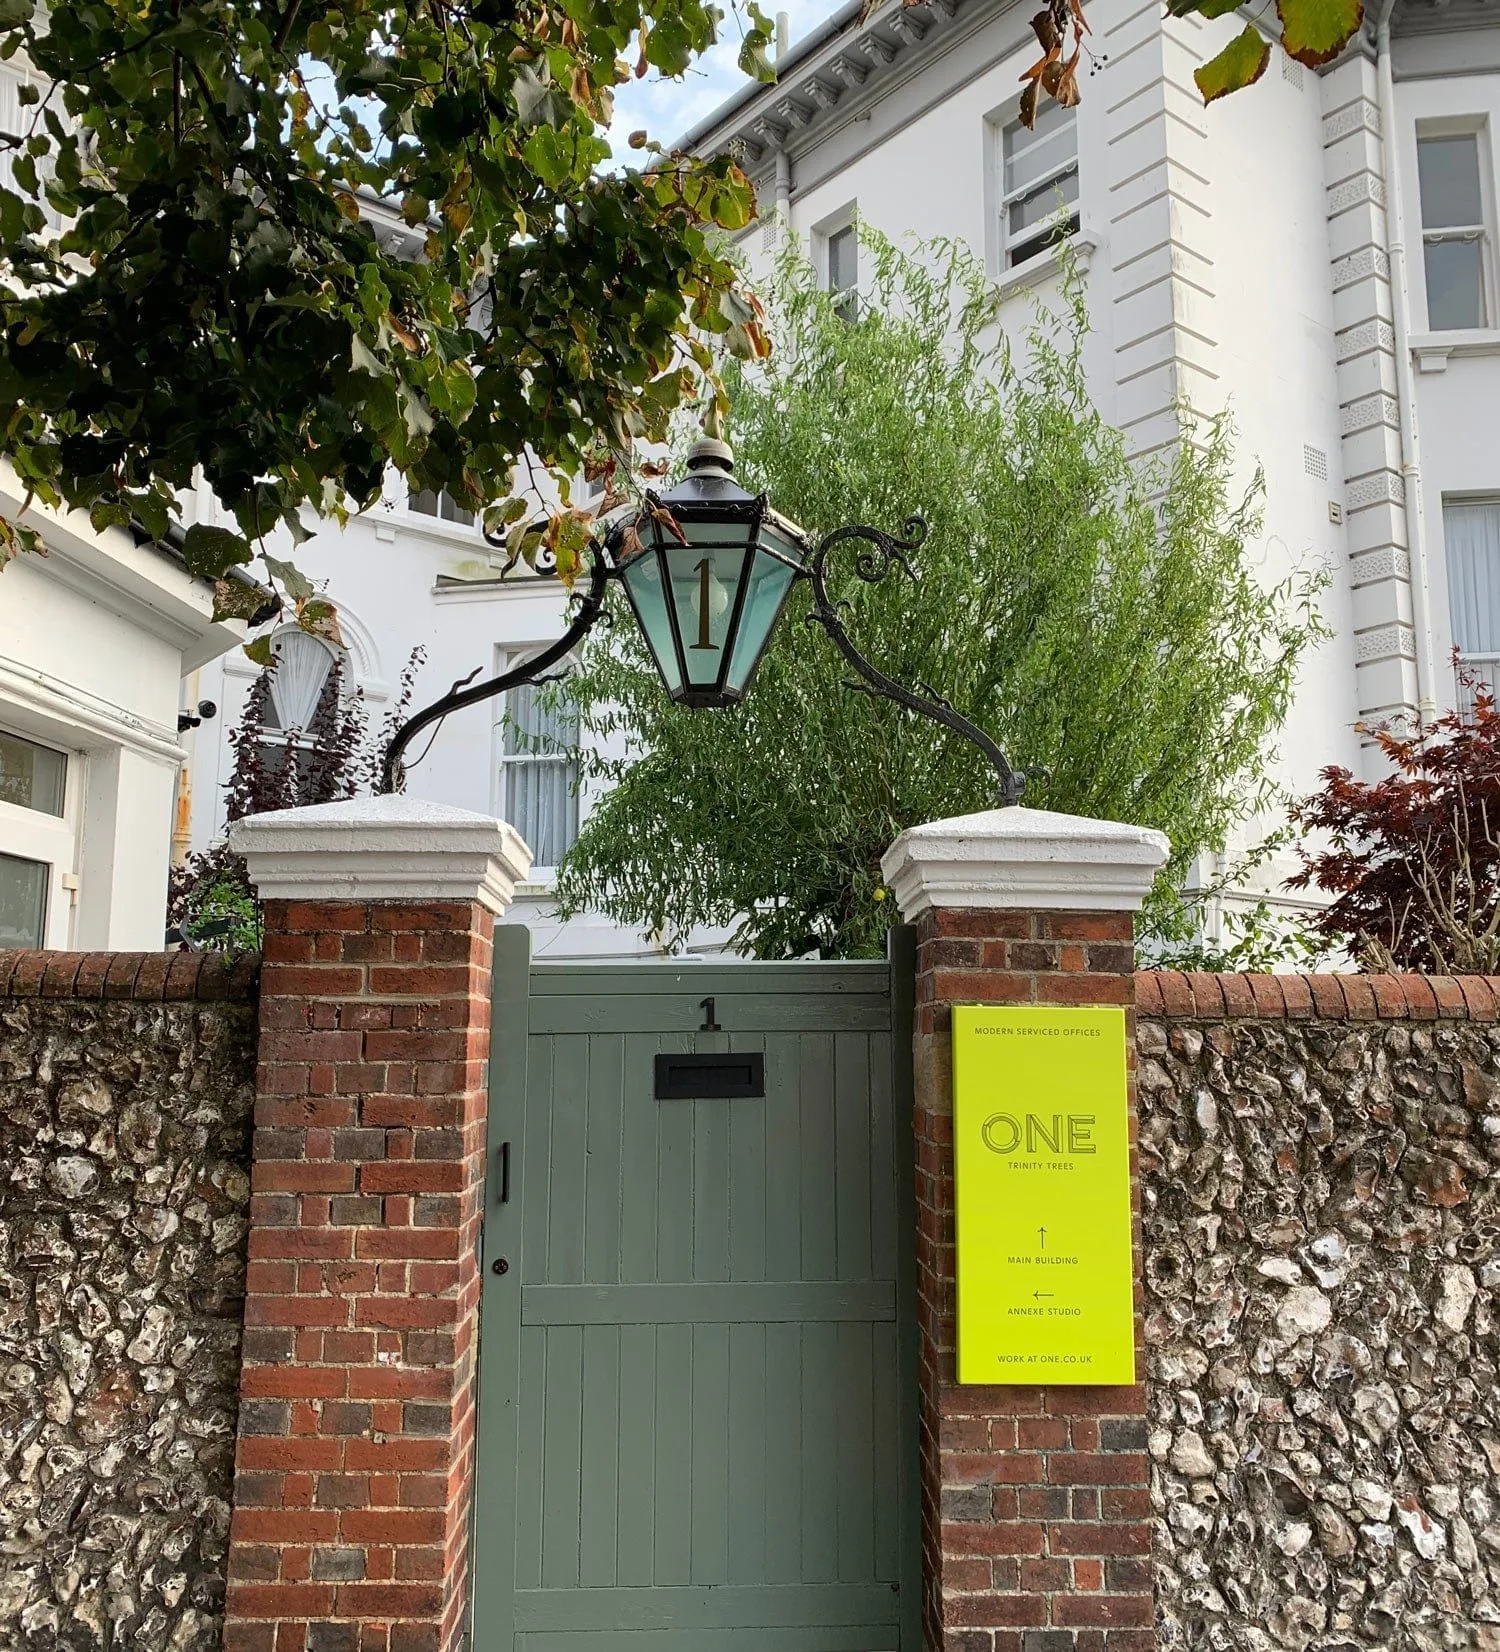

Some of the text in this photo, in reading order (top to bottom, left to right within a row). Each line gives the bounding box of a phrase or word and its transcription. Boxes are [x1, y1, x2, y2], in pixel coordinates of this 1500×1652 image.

[689, 558, 720, 650] 1
[700, 997, 721, 1032] 1
[975, 1027, 1100, 1036] MODERN SERVICED OFFICES
[981, 1112, 1096, 1154] ONE
[1008, 1161, 1074, 1170] TRINITY TREES
[1007, 1256, 1079, 1265] MAIN BUILDING
[1007, 1307, 1081, 1316] ANNEXE STUDIO
[997, 1355, 1092, 1363] WORK AT ONE.CO.UK
